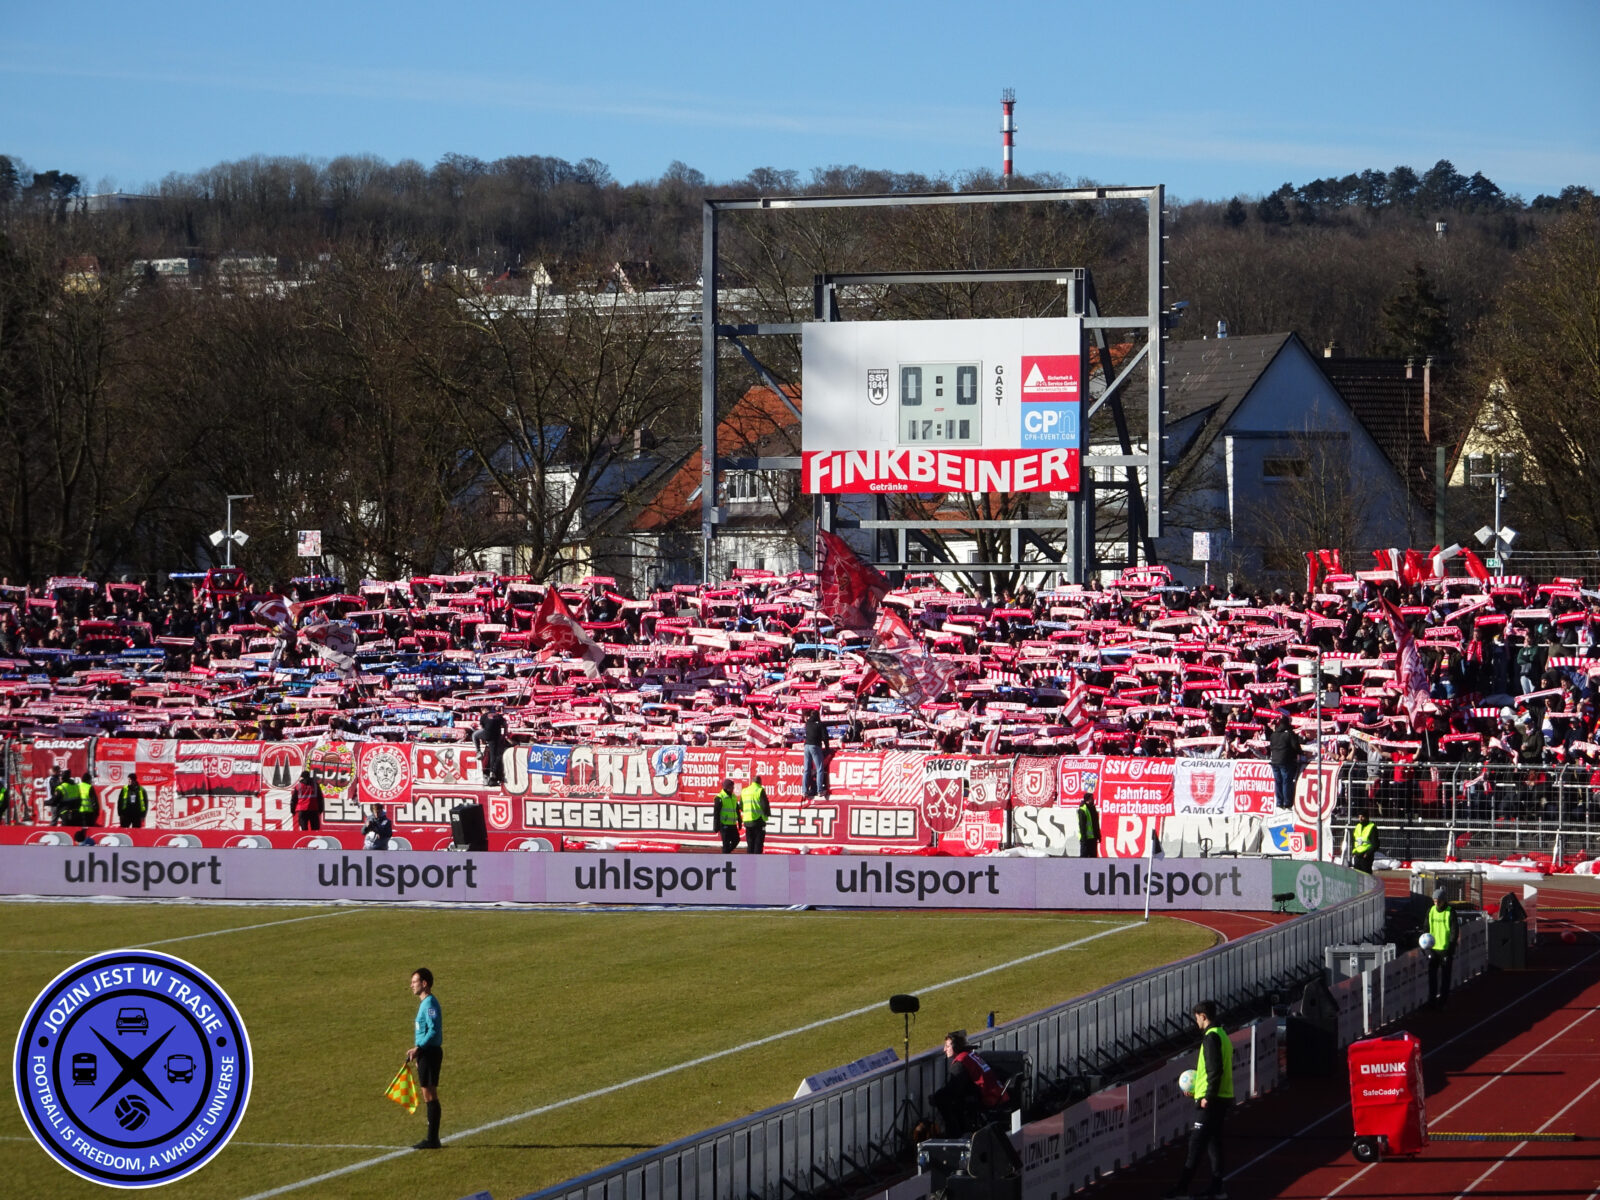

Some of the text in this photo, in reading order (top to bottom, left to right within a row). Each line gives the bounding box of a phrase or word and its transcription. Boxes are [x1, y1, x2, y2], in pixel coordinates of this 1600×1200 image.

[869, 374, 888, 382] SSV
[869, 381, 888, 389] 1846
[995, 365, 1004, 406] GAST
[810, 449, 1070, 493] FINKBEINER
[869, 483, 908, 491] Getränke
[180, 743, 260, 755] DONAUKOMMANDO
[684, 752, 721, 762] SEKTION
[682, 764, 719, 774] STADION
[756, 761, 774, 776] Die
[830, 762, 880, 786] JGS
[1105, 760, 1175, 775] SSV Jahn
[1235, 763, 1275, 778] SEKTION
[682, 775, 720, 787] VERBOT
[1234, 780, 1276, 793] BAYERWALD
[550, 780, 614, 798] Regensburg
[1114, 786, 1162, 799] Jahnfans
[1102, 800, 1172, 814] Beratzhausen
[1181, 805, 1225, 815] AMICIS
[1260, 797, 1274, 813] 25
[525, 801, 915, 836] REGENSBURG SEIT 1889
[64, 852, 222, 891] uhlsport
[319, 856, 477, 895] uhlsport
[574, 858, 737, 898] uhlsport
[835, 861, 999, 900] uhlsport
[1083, 863, 1242, 903] uhlsport
[1371, 1062, 1407, 1074] MUNK
